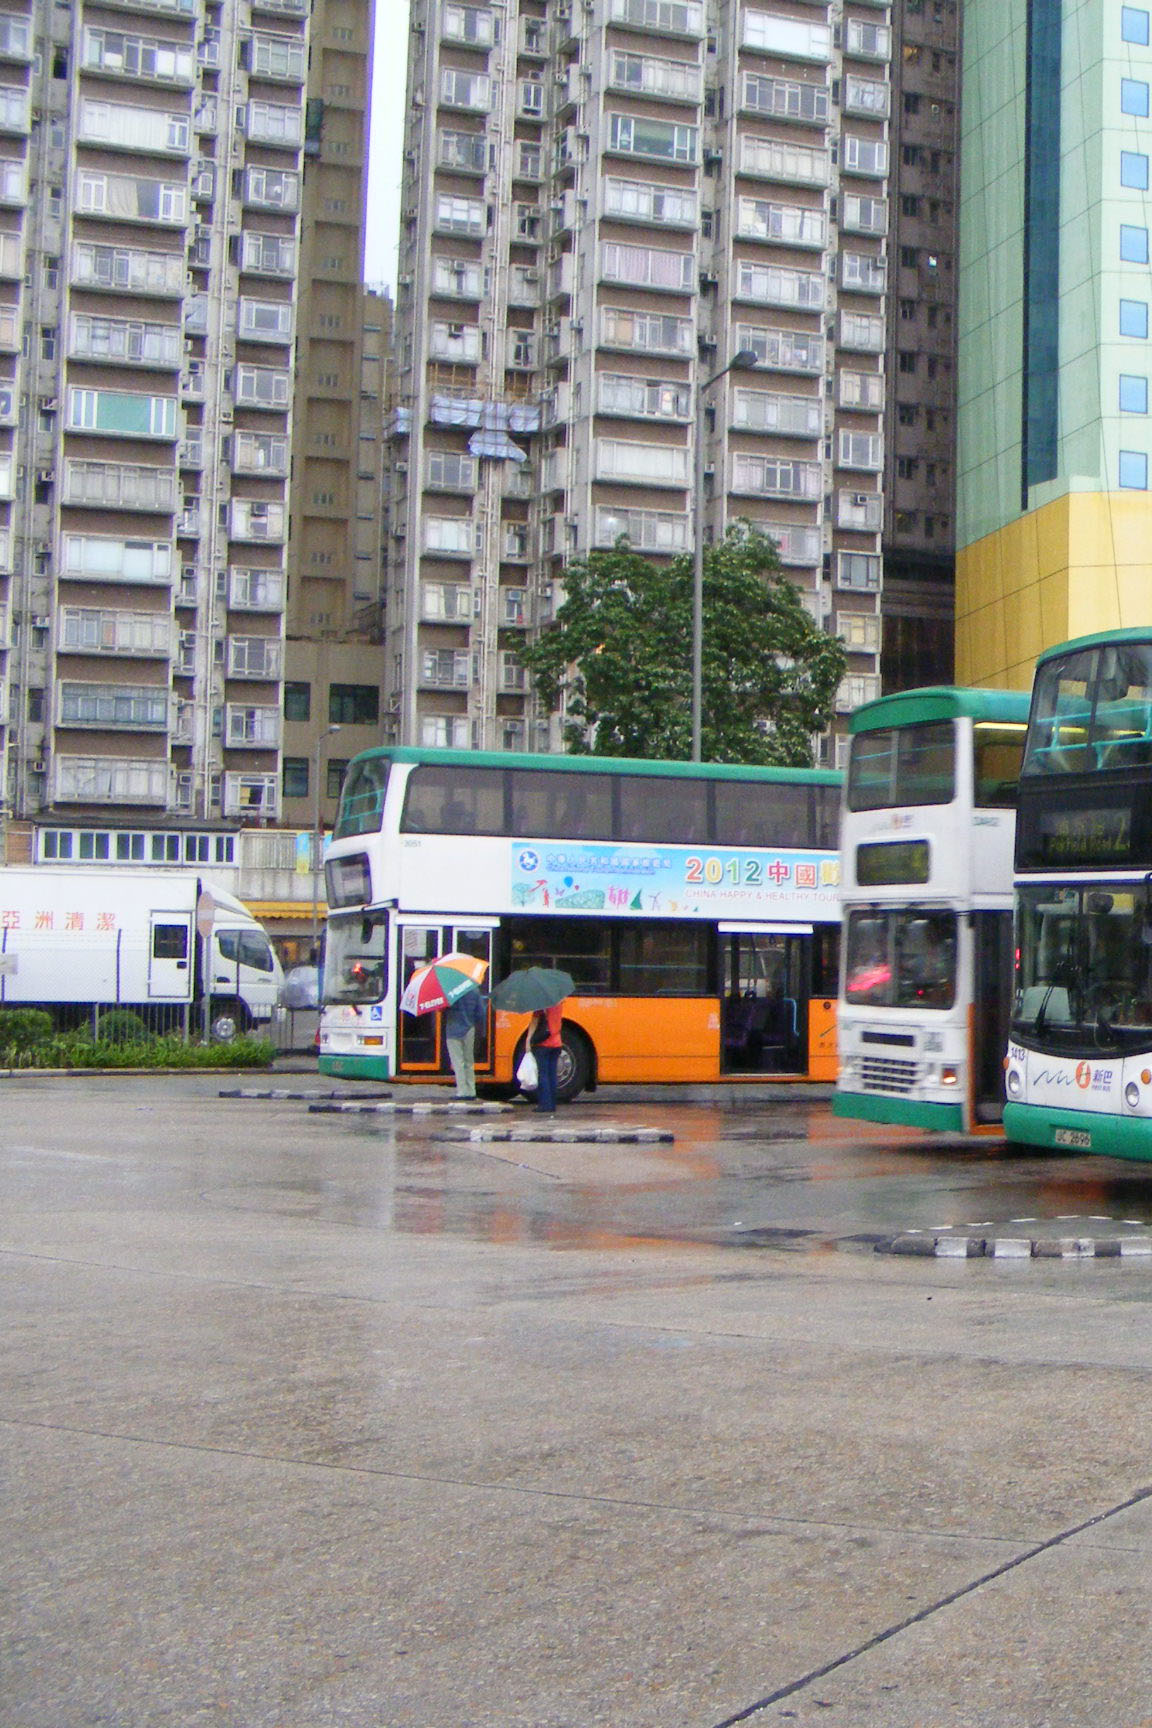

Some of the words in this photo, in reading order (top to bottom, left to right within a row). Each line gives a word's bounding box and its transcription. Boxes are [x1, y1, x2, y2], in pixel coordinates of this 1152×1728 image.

[720, 890, 753, 899] HAPPY
[1, 910, 117, 931] 亞洲清潔
[1010, 1047, 1026, 1062] 1413
[1092, 1069, 1113, 1084] 新巴
